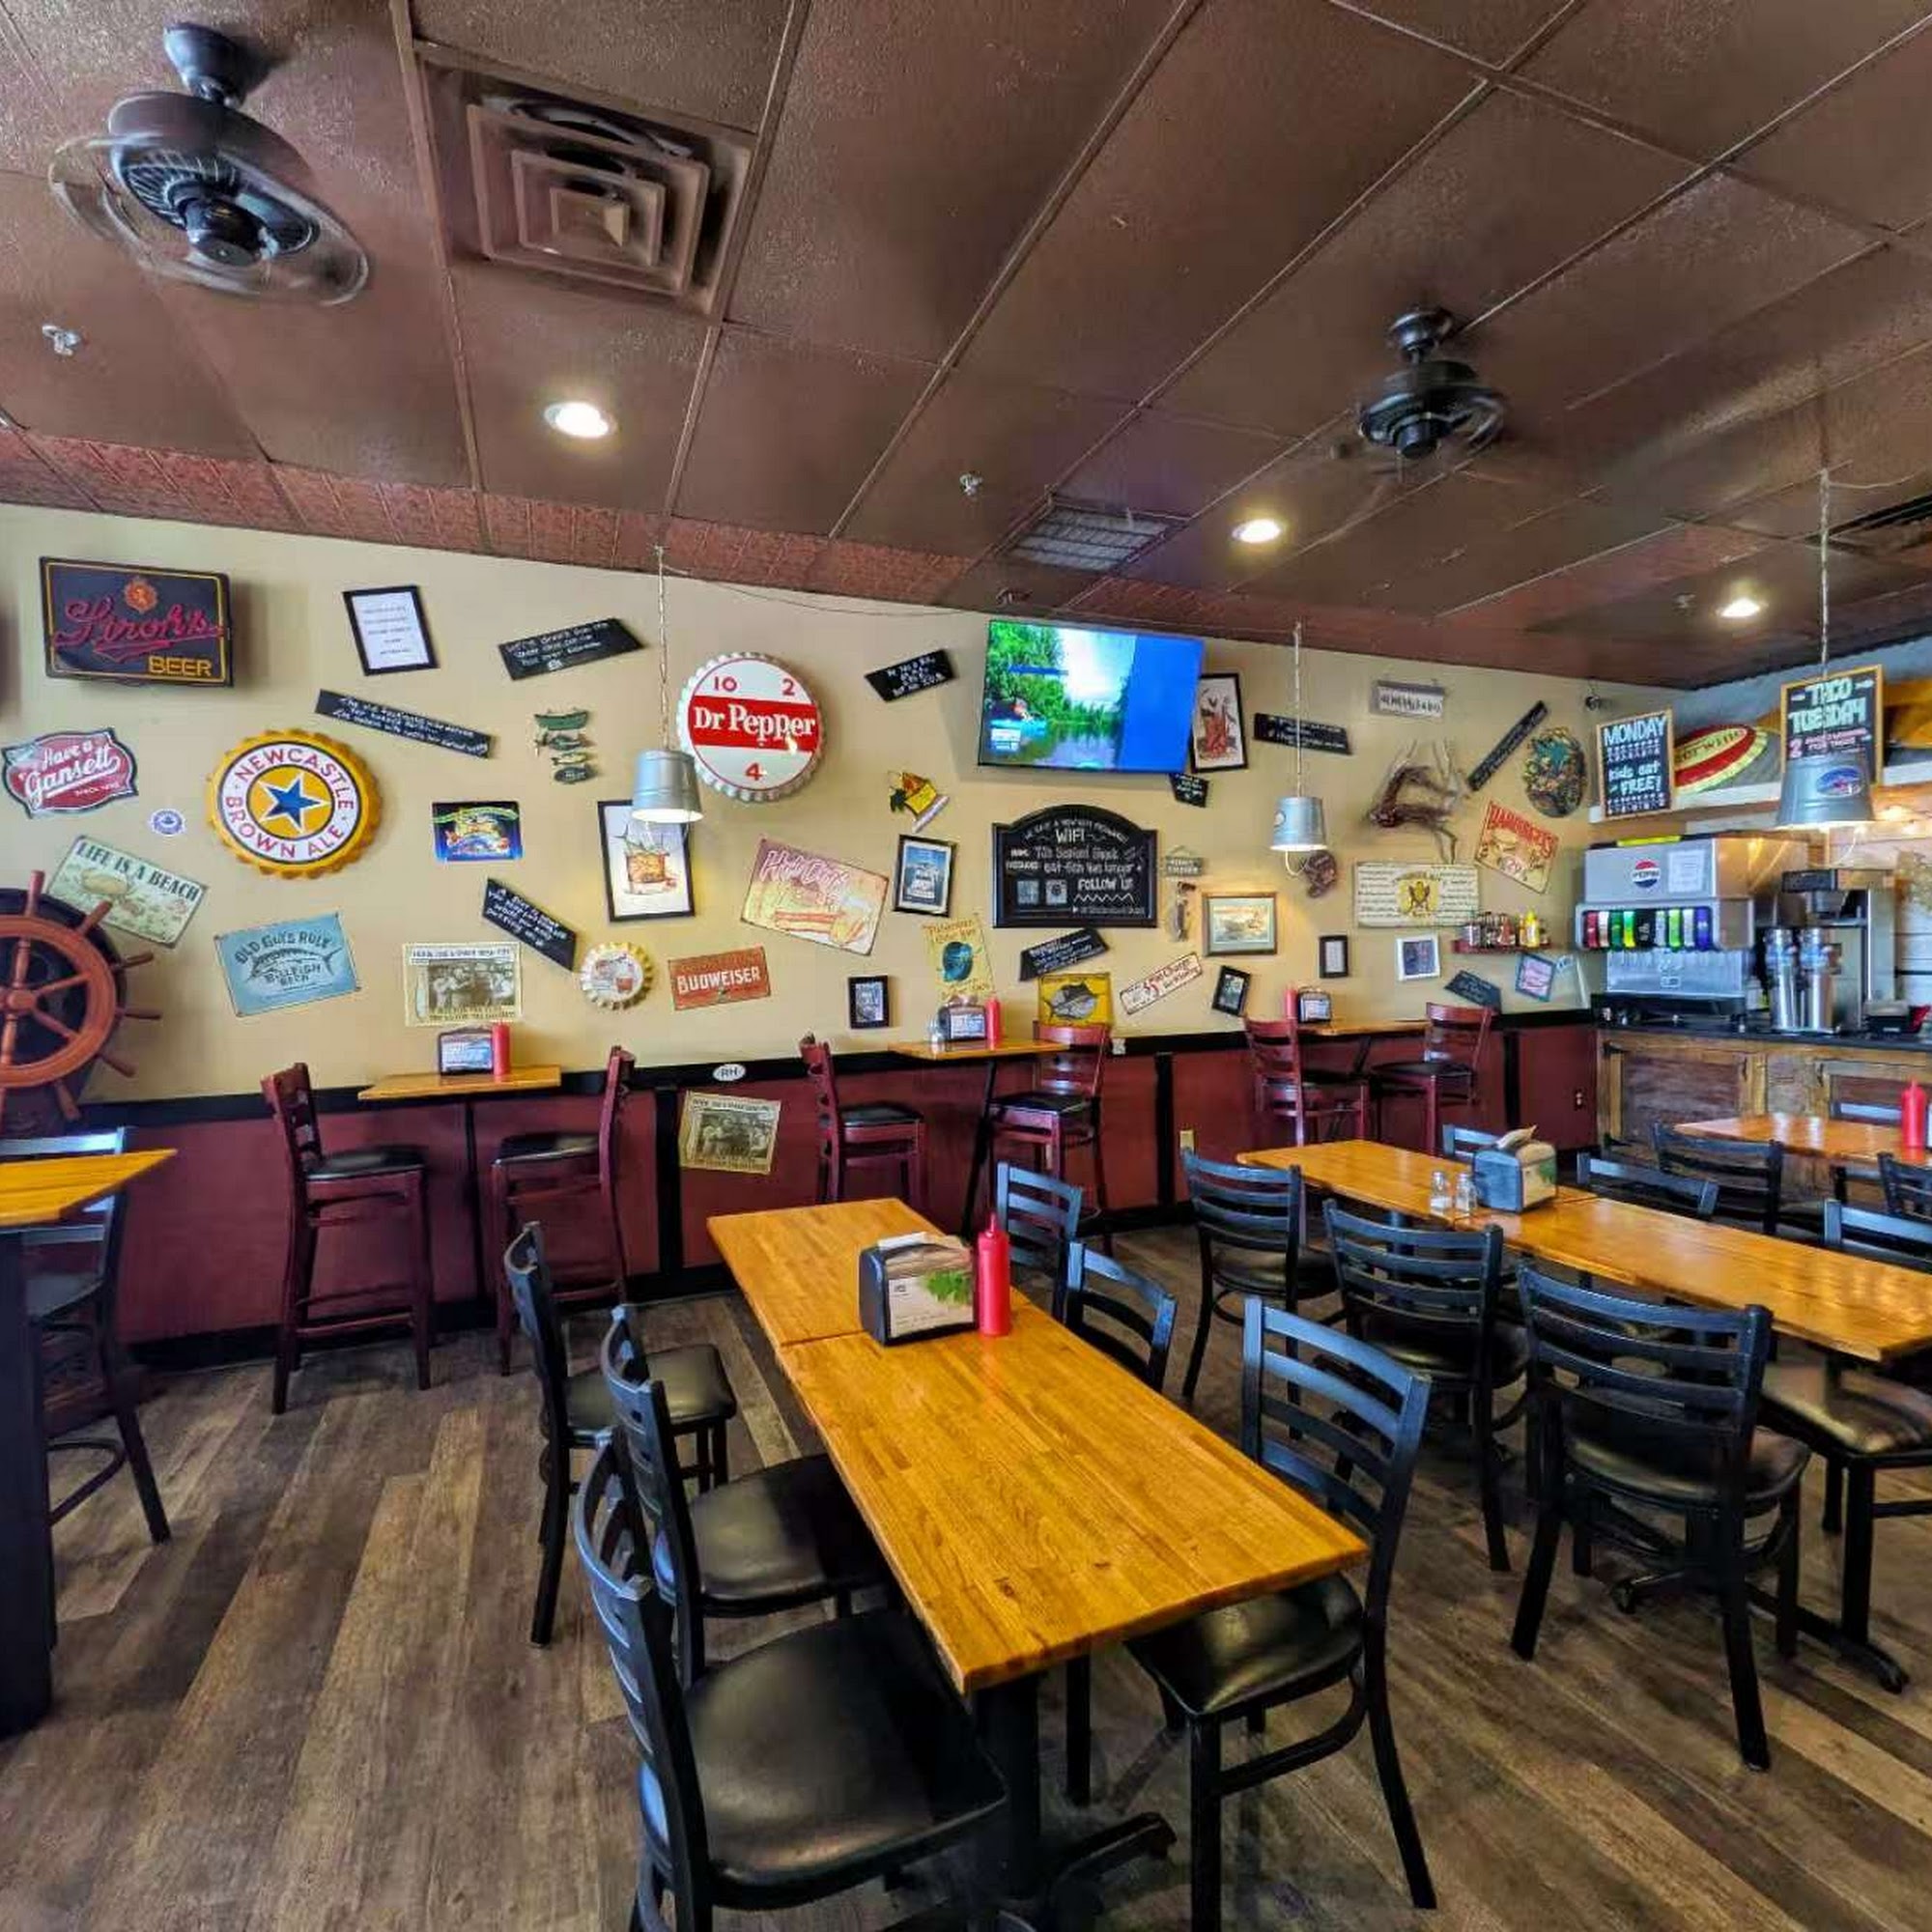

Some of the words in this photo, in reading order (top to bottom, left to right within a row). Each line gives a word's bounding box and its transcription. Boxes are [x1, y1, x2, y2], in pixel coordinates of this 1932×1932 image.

[149, 656, 212, 676] BEER
[714, 676, 737, 692] 10
[781, 679, 795, 696] 2
[694, 706, 724, 730] Dr
[728, 703, 815, 741] Pepper
[1605, 716, 1666, 746] MONDAY
[42, 745, 81, 770] Have
[745, 763, 763, 781] 4
[235, 748, 355, 810] NEWCASTLE
[226, 796, 295, 858] BROWN
[308, 825, 344, 857] ALE
[75, 842, 111, 867] LIFE
[114, 857, 129, 873] IS
[133, 866, 147, 880] A
[149, 870, 200, 901] BEACH
[234, 941, 260, 964] OLD
[676, 966, 761, 995] BUDWEISER
